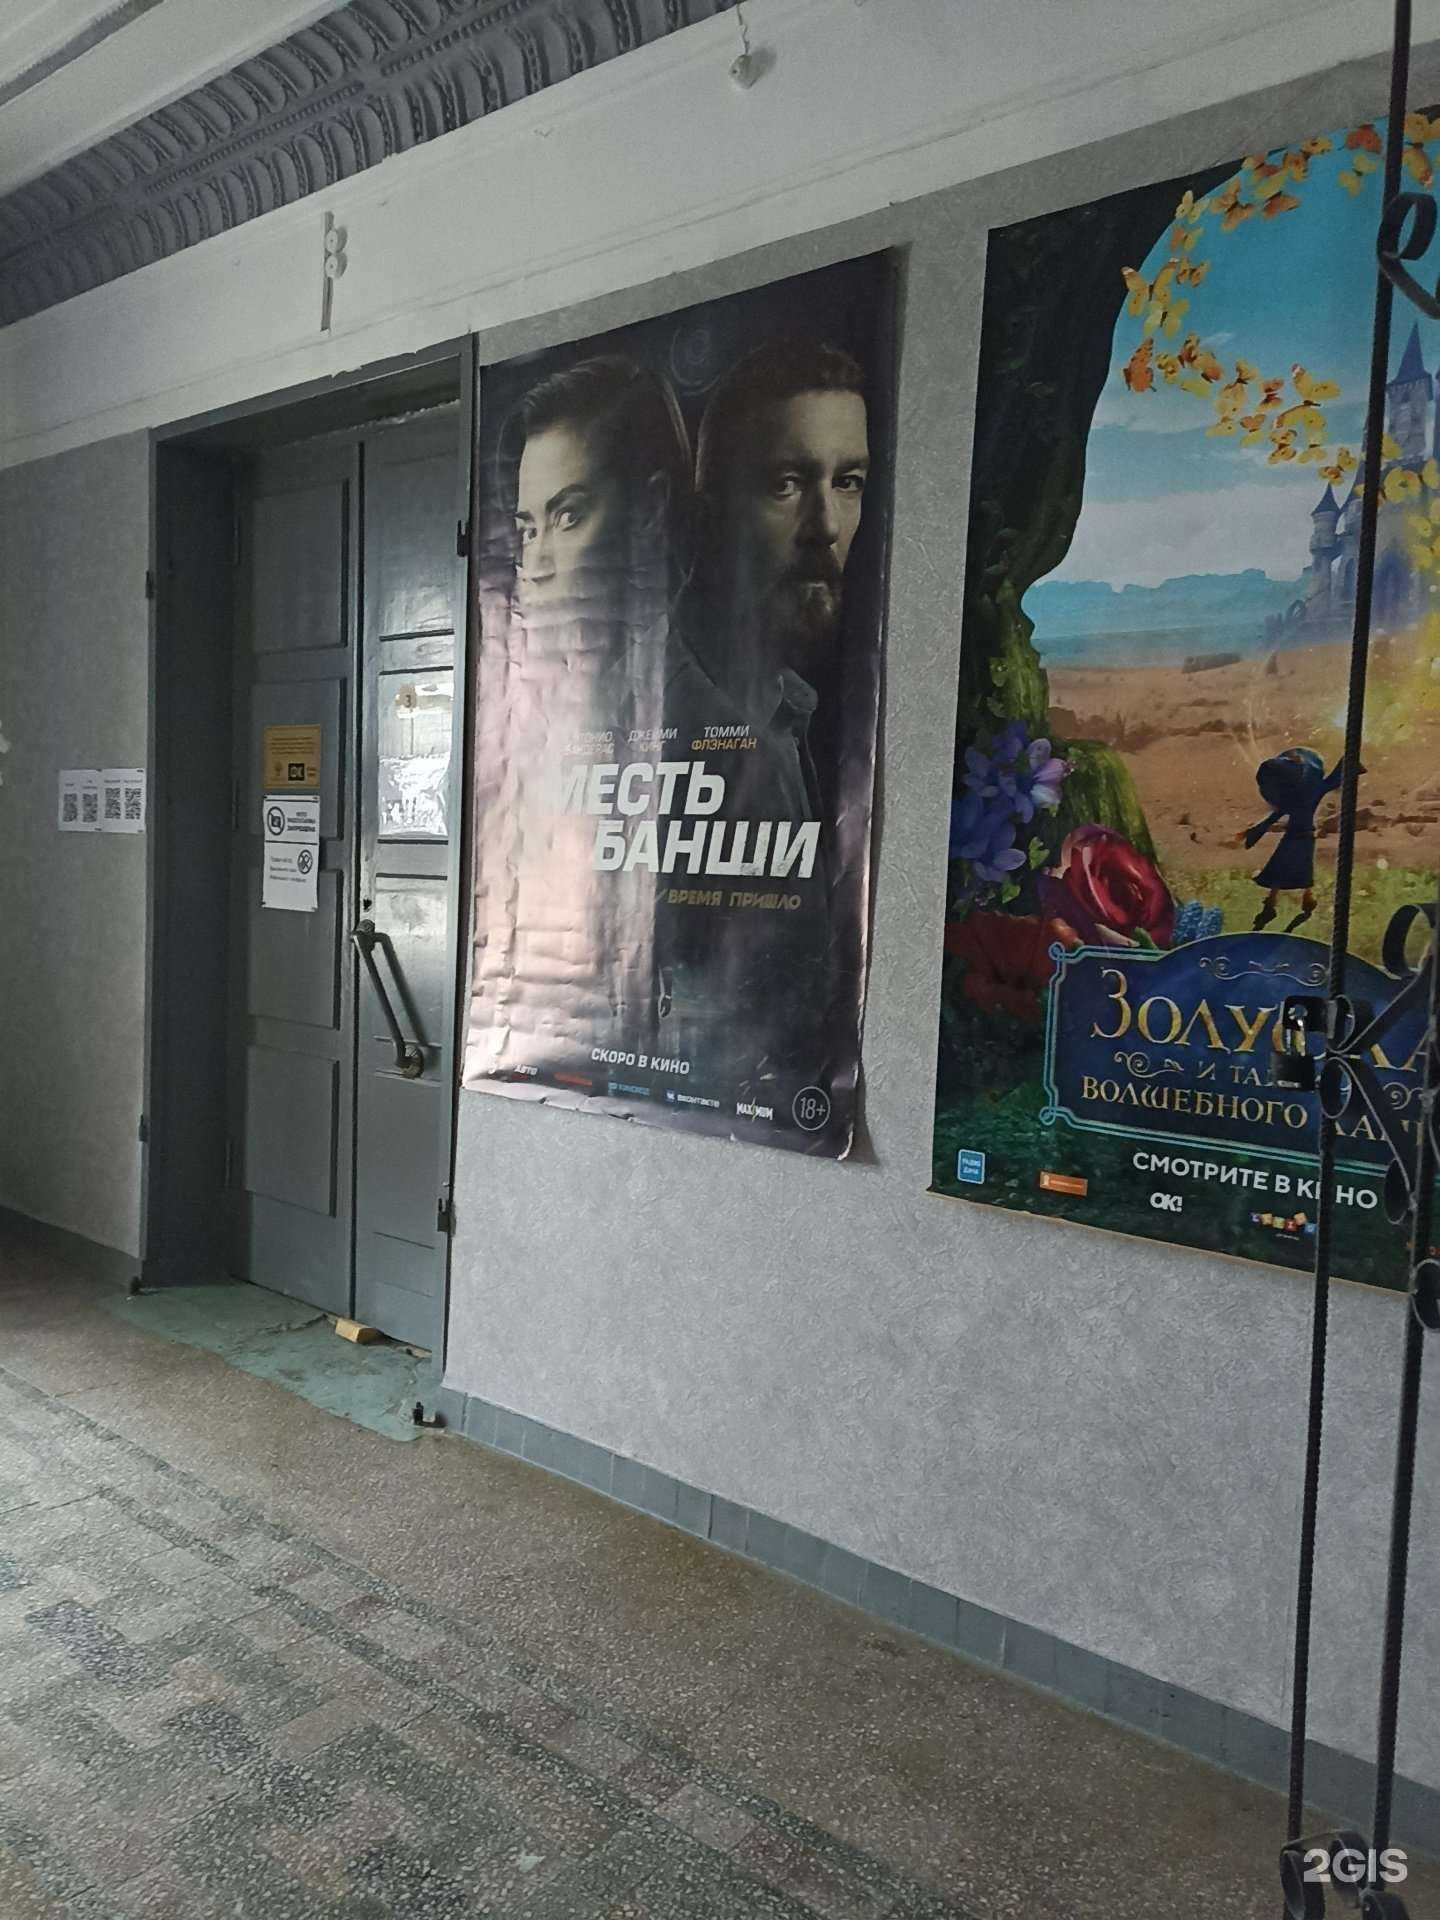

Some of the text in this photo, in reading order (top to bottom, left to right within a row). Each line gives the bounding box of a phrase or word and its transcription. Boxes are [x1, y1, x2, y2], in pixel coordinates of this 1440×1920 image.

[691, 737, 757, 751] ФЛЭНАГАН
[704, 725, 750, 739] ТОММИ
[592, 820, 821, 878] БАНШИ
[668, 889, 802, 910] ВРЕМЯ ПРИШЛО
[591, 1048, 690, 1075] СКОРО В КИНО
[800, 1096, 826, 1120] 18+
[1081, 1075, 1308, 1129] ВОЛШЕБНОГО
[1132, 1152, 1269, 1191] СМОТРИТЕ
[1275, 1174, 1290, 1194] В
